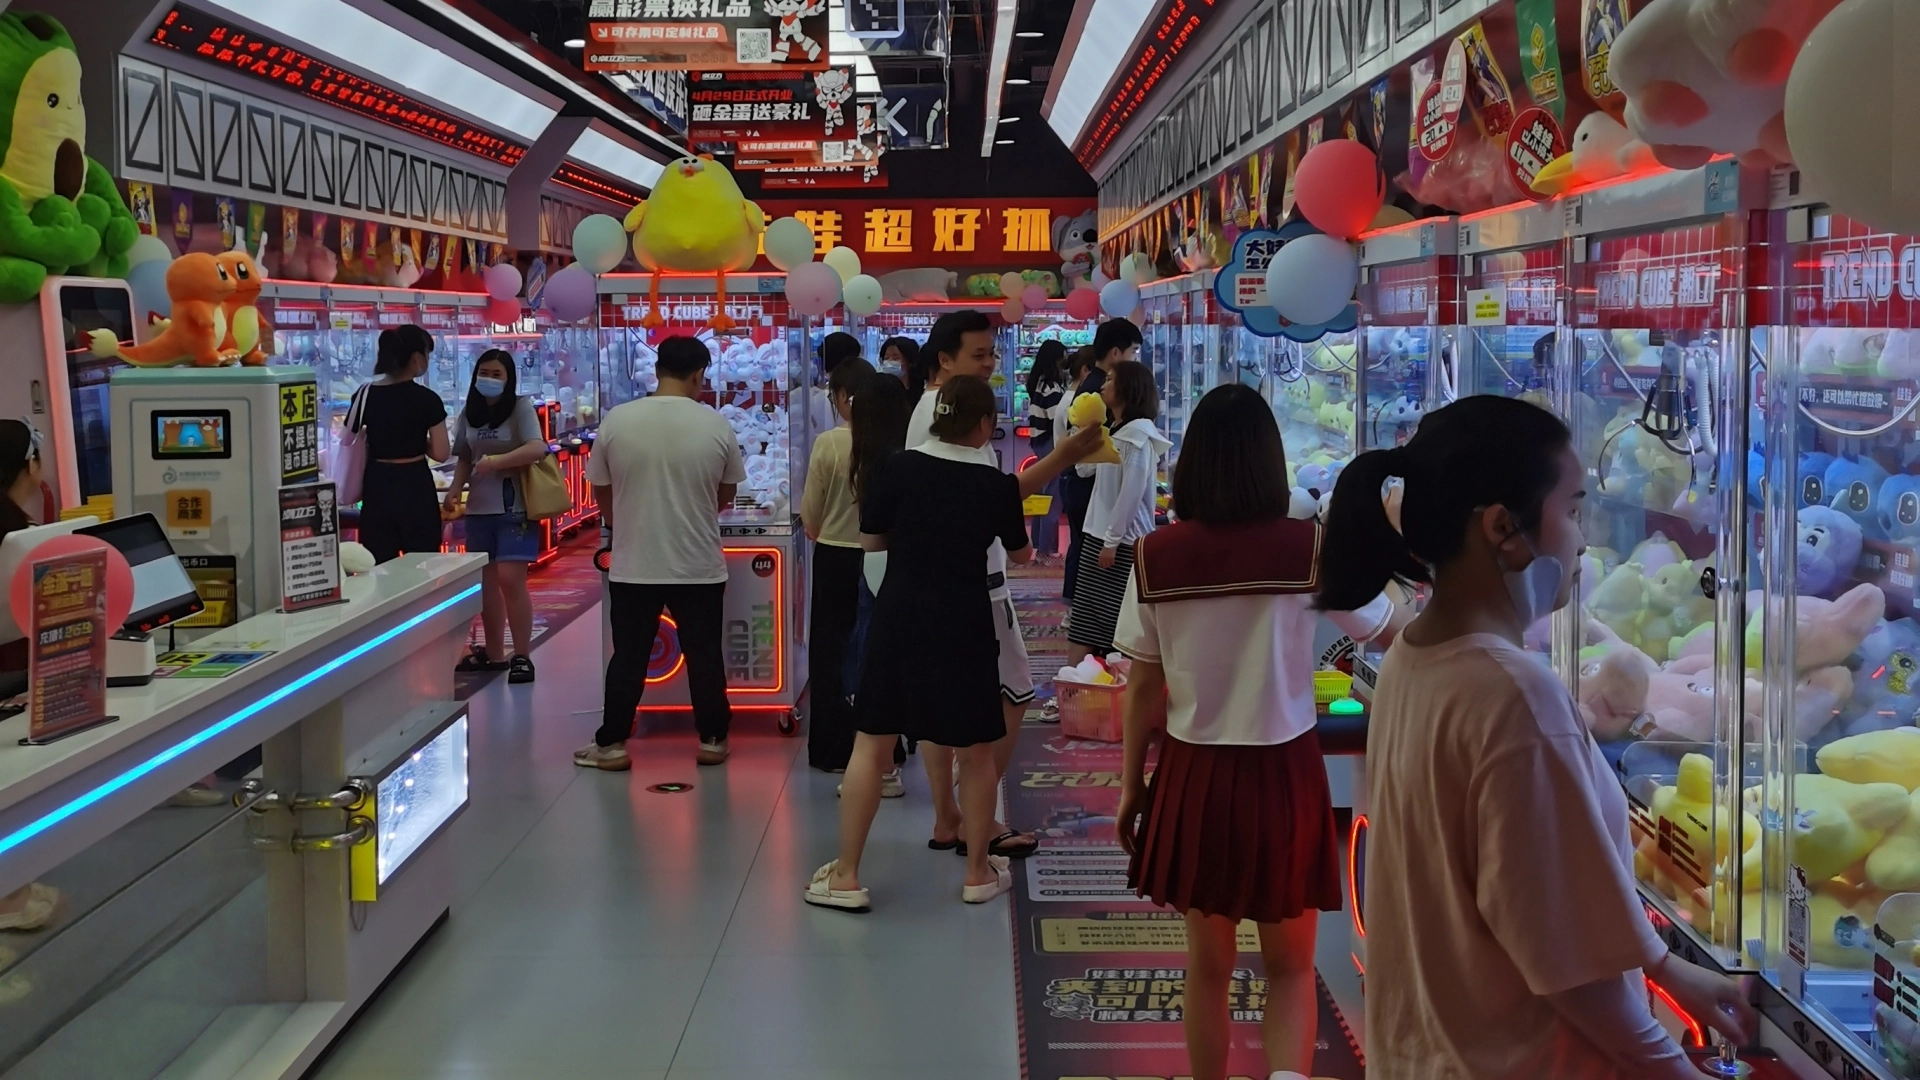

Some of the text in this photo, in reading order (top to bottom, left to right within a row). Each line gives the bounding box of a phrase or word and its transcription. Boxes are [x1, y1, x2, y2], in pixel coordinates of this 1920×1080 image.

[691, 90, 793, 101] 4月29日正式开业
[692, 103, 811, 122] 砸金蛋送豪礼
[759, 207, 1051, 254] 娃超好抓
[1821, 241, 1893, 308] TREND
[1595, 267, 1637, 312] TREND
[1640, 264, 1676, 308] CUBE
[674, 306, 710, 320] CUBE
[904, 316, 930, 325] TREND
[283, 385, 315, 422] 本店
[284, 425, 315, 451] 不提供
[177, 496, 203, 509] 合作
[177, 509, 203, 521] 商家
[754, 560, 772, 570] 44
[727, 619, 749, 681] CUBE
[751, 601, 775, 681] TREND
[1321, 635, 1351, 663] SUPER
